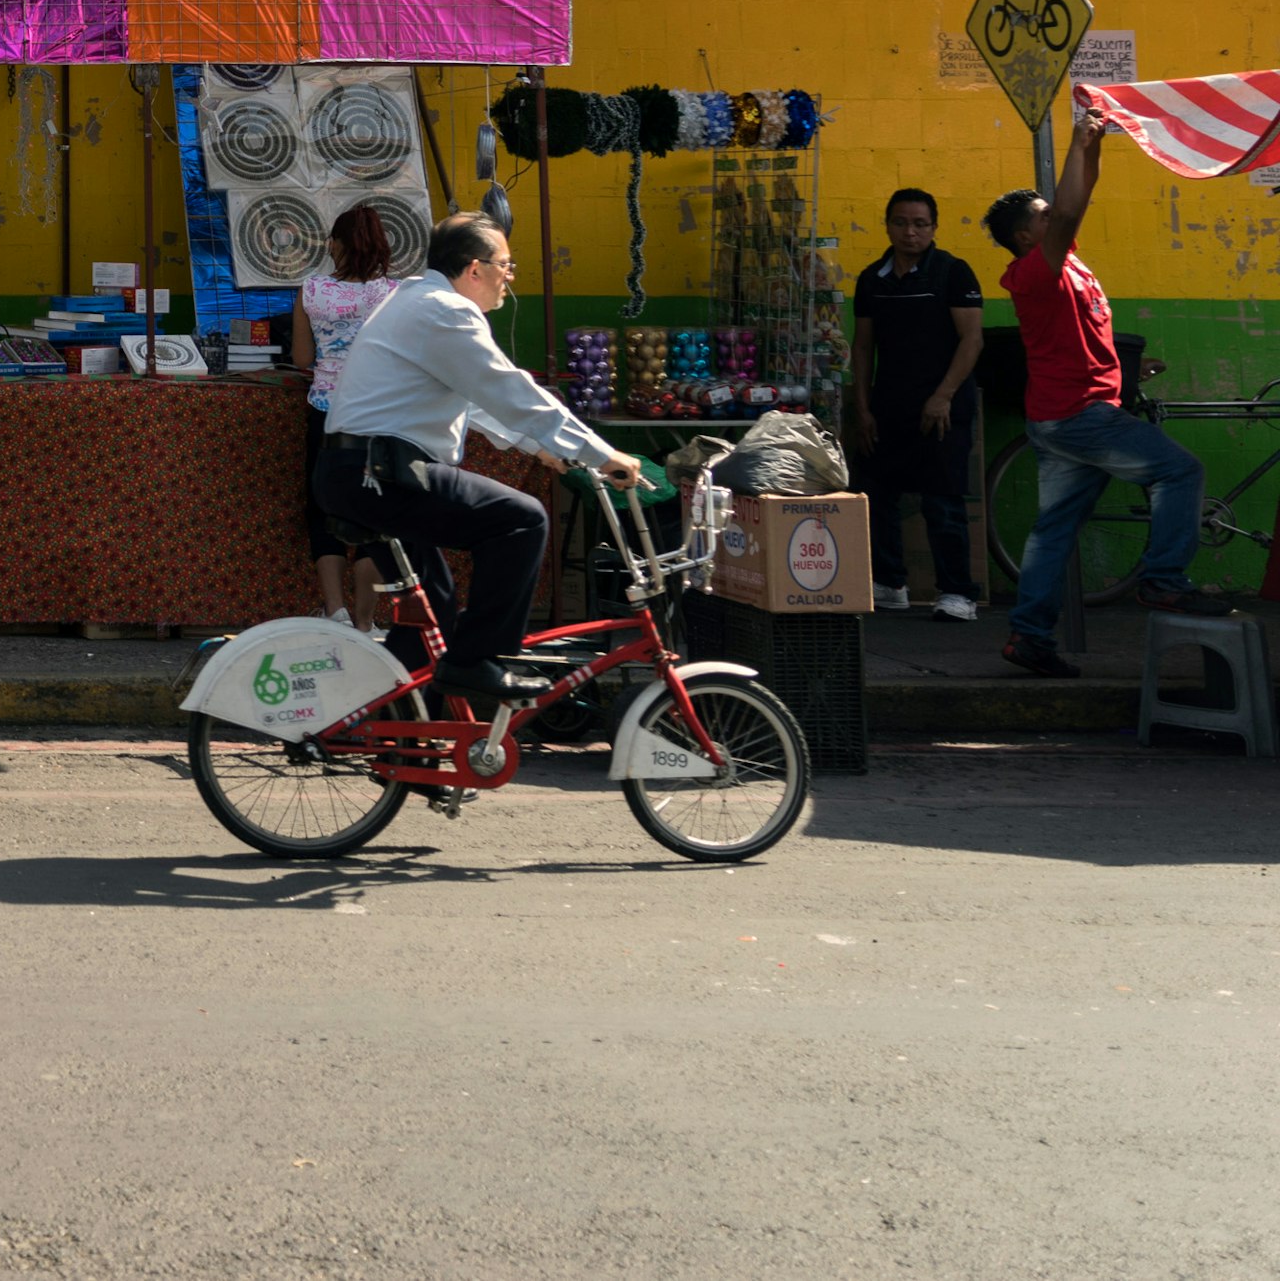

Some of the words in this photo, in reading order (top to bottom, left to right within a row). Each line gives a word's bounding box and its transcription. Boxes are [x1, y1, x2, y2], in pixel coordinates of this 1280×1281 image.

[1087, 39, 1132, 52] SOLICITA
[1118, 51, 1133, 61] DE
[782, 503, 841, 515] PRIMERA
[724, 532, 746, 549] HUEVO
[800, 543, 826, 557] 360
[793, 560, 834, 570] HUEVOS
[787, 594, 843, 606] CALIDAD
[253, 653, 289, 705] 6
[292, 677, 316, 691] AÑOS
[277, 707, 315, 721] CDMX
[651, 751, 688, 768] 1899
